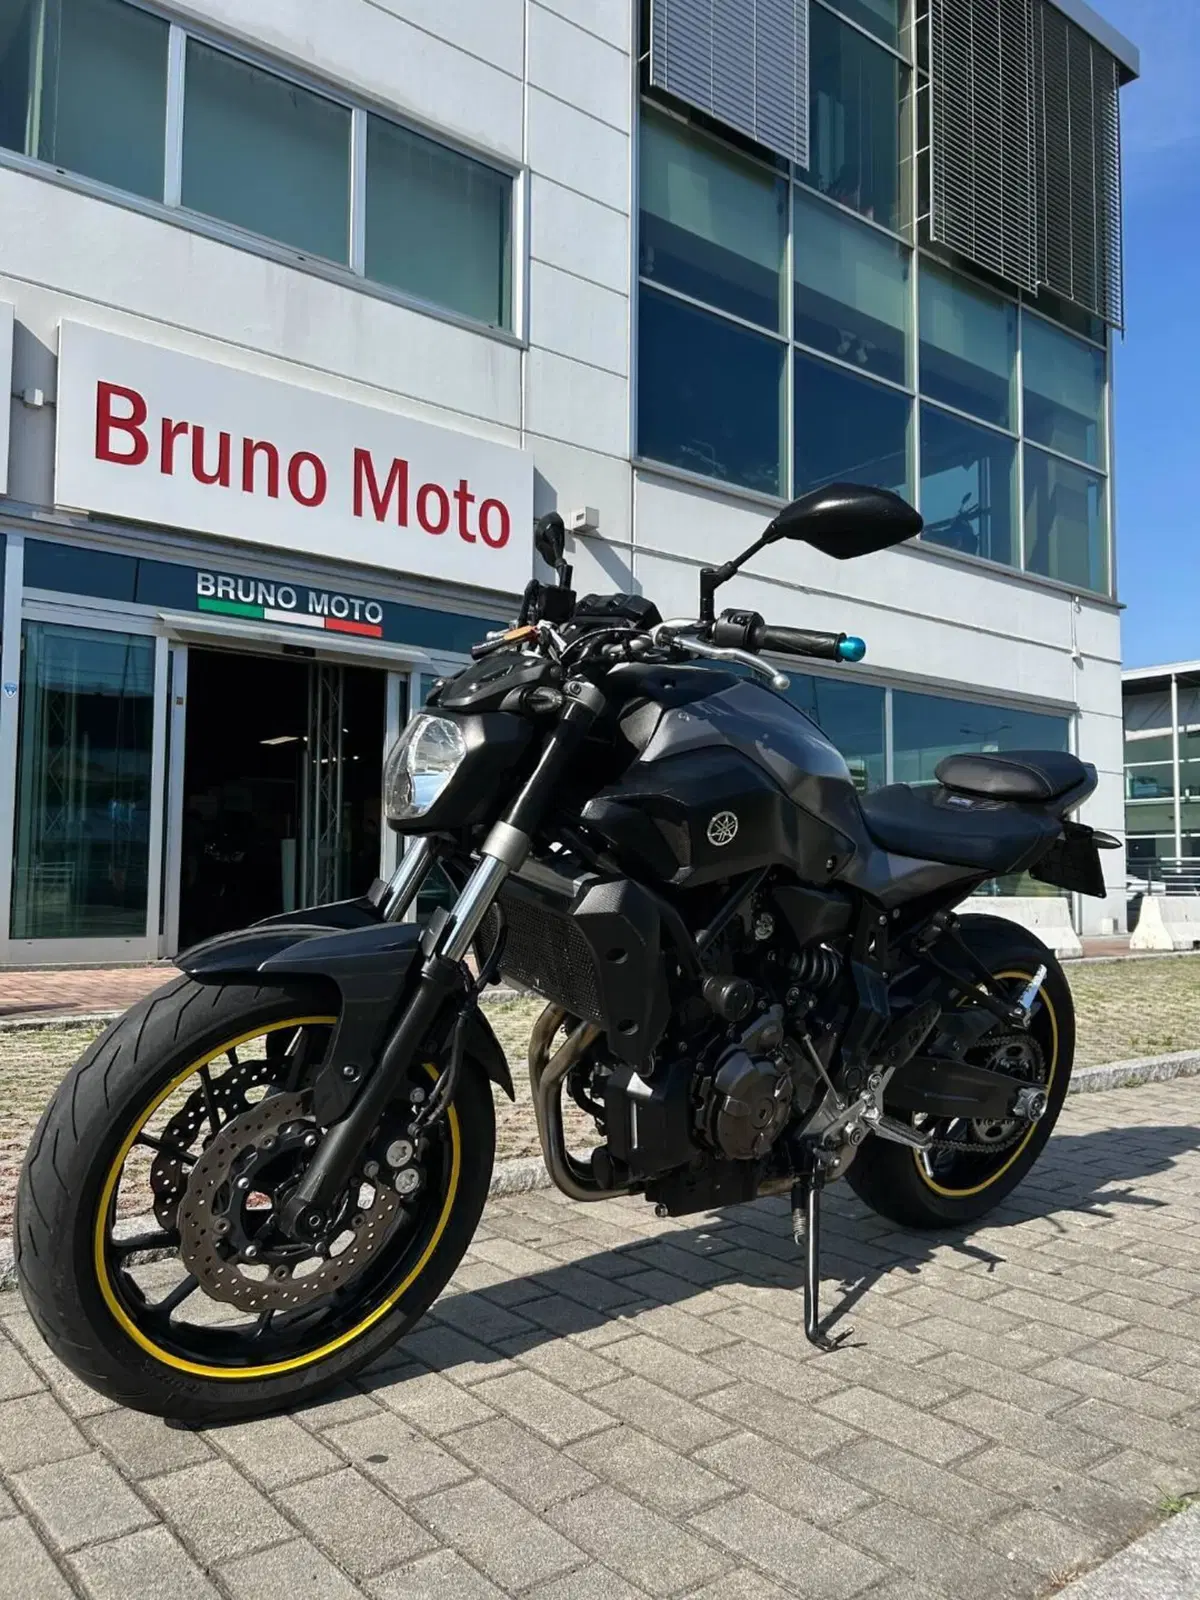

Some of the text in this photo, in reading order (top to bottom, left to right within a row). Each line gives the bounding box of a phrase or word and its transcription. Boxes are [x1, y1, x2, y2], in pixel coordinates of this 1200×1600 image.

[95, 380, 511, 549] Bruno Moto
[196, 572, 383, 624] BRUNO MOTO
